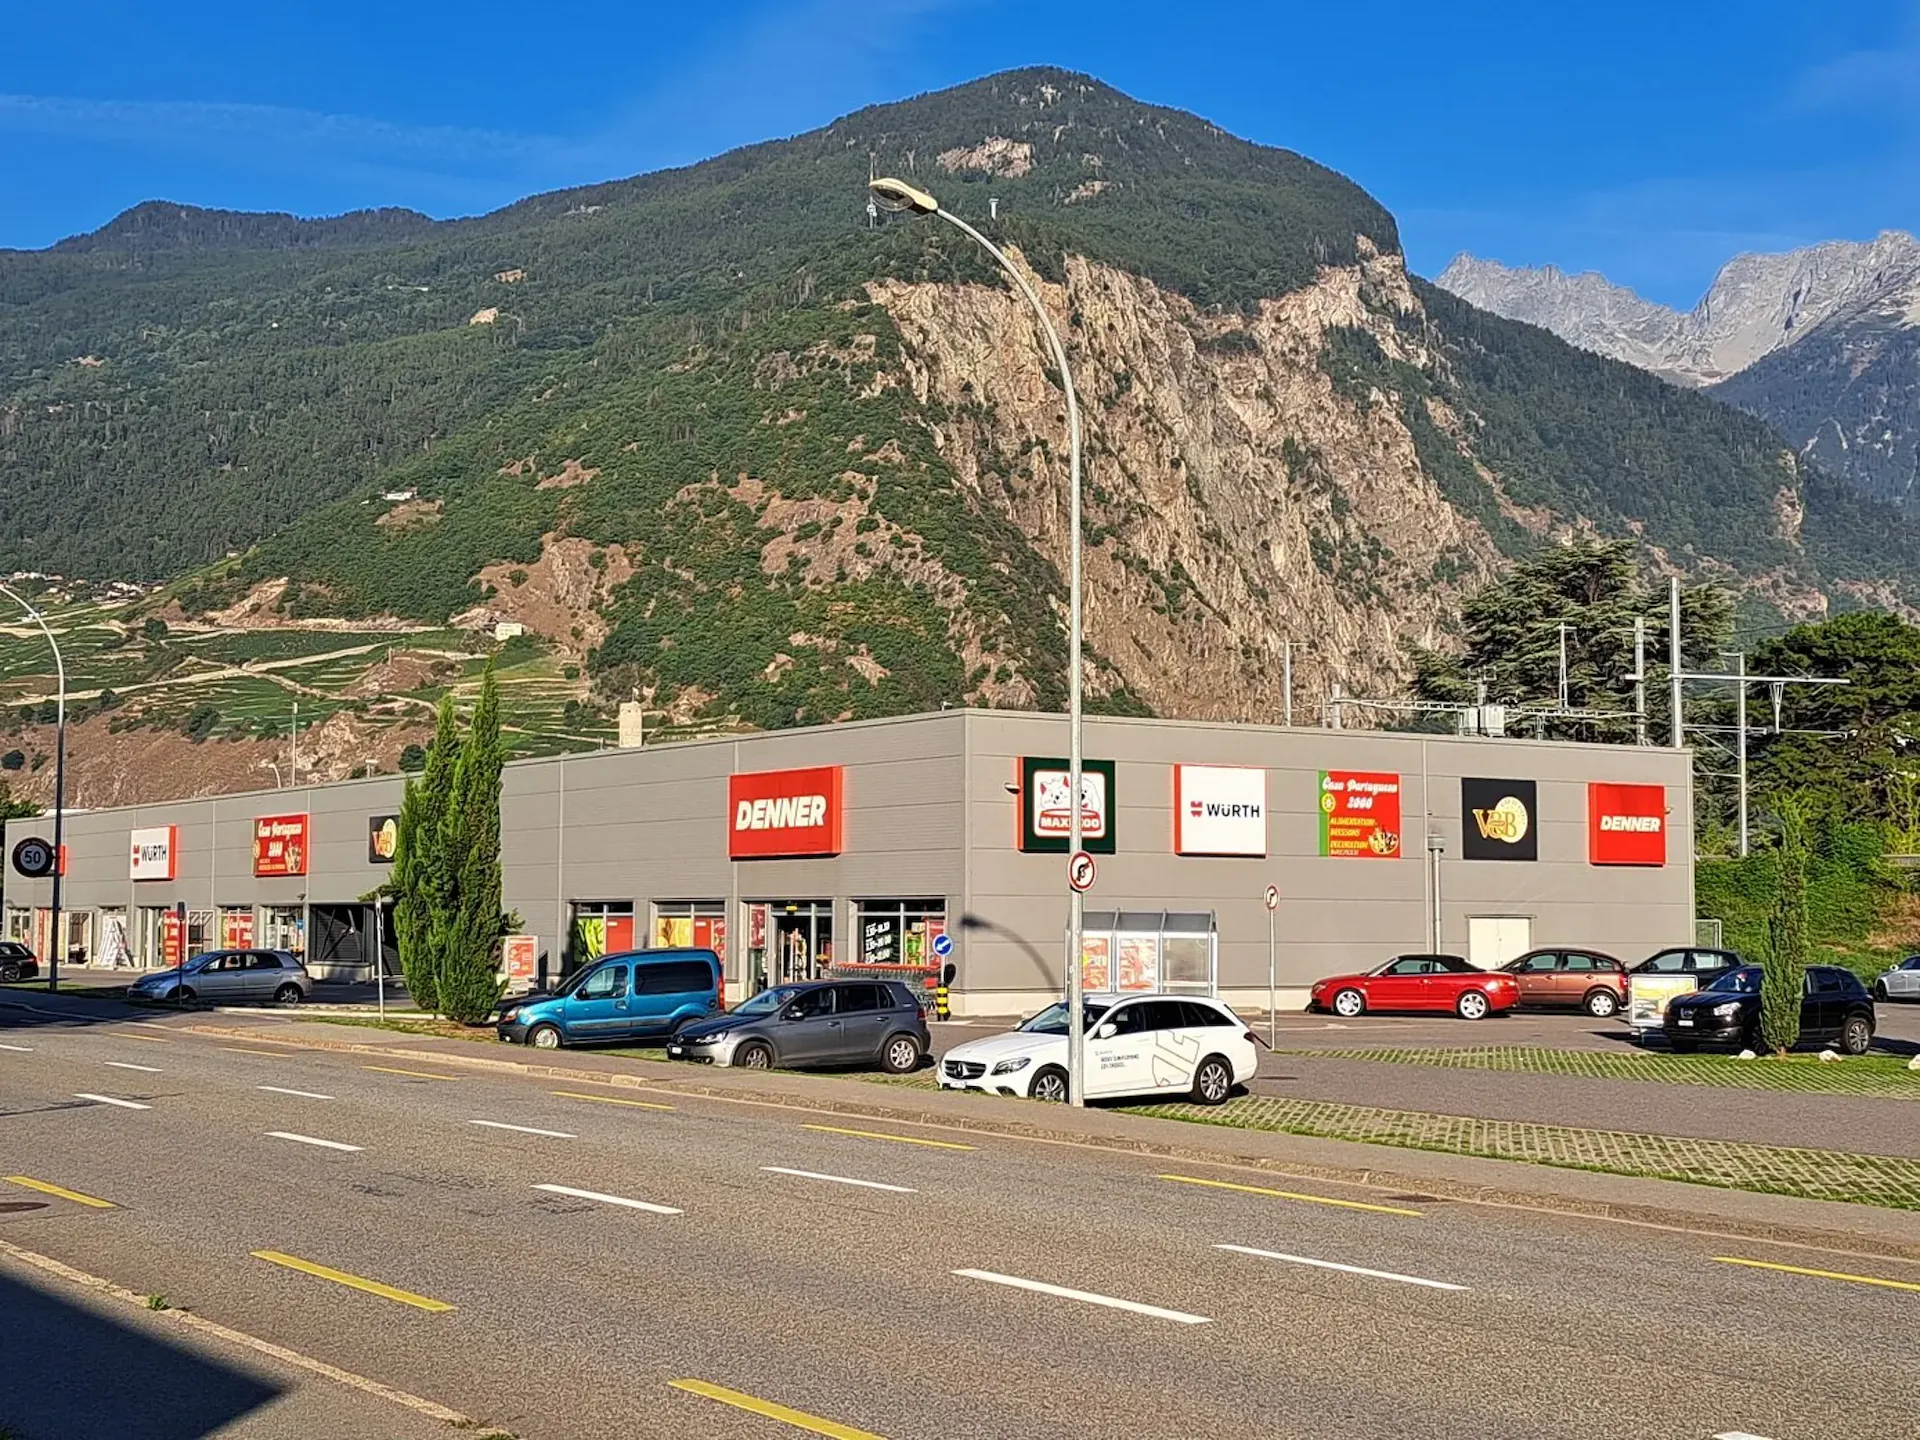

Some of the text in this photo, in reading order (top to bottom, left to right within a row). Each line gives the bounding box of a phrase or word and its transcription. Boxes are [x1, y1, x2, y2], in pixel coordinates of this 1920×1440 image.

[735, 795, 827, 831] DENNER
[1206, 803, 1260, 818] WÜRTH
[1600, 815, 1661, 832] DENNER
[24, 850, 41, 864] 50
